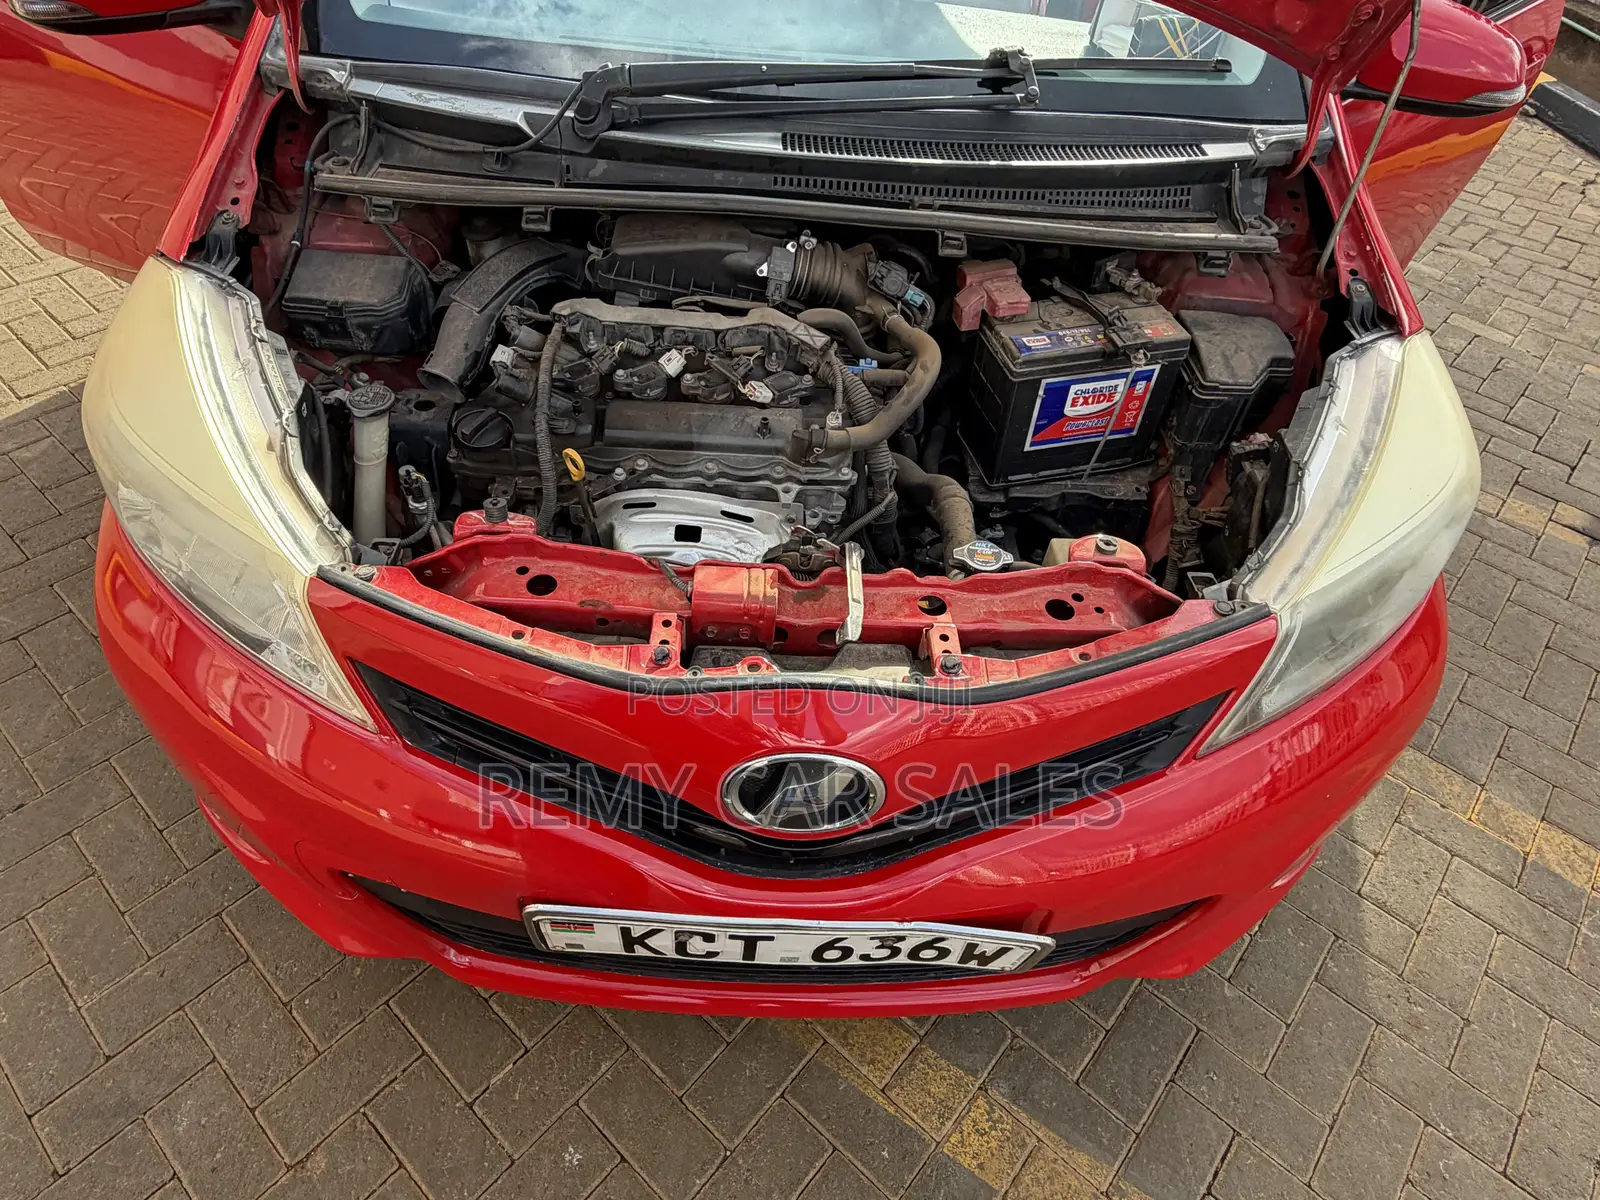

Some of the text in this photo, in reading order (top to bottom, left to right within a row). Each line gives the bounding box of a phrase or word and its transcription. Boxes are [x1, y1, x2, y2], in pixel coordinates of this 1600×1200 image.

[1074, 384, 1120, 396] CHLORIDE
[1070, 392, 1117, 408] EXIDE
[619, 925, 776, 962] KCT
[811, 936, 1014, 968] 636W
